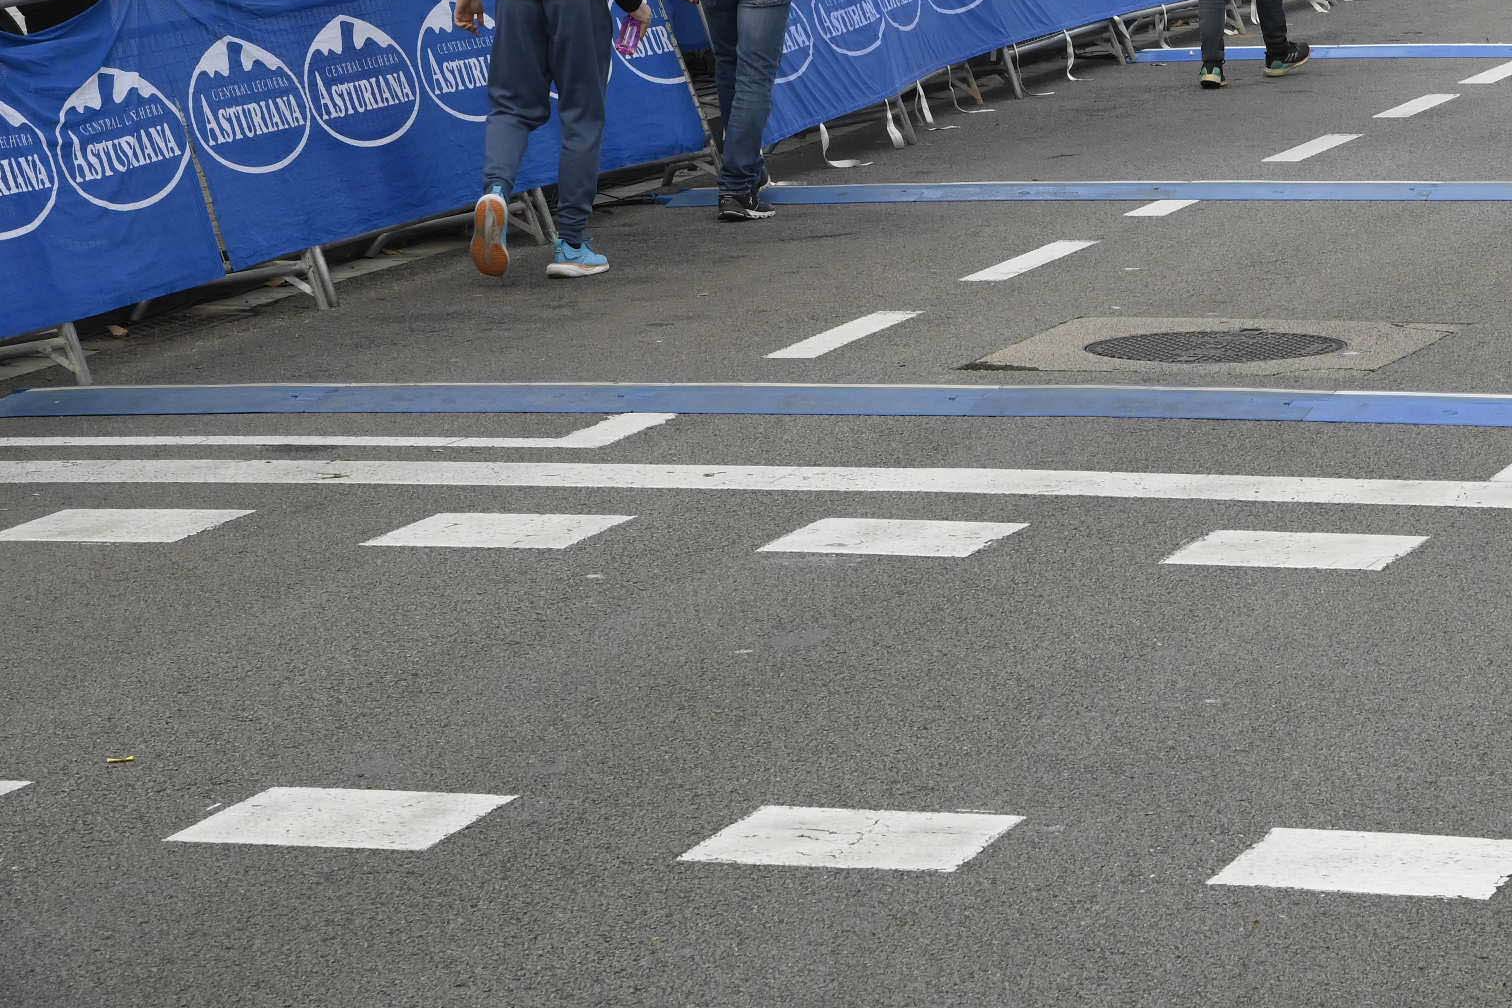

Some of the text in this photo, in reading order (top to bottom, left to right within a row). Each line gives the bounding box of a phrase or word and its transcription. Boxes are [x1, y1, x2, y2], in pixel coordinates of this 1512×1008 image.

[325, 54, 400, 77] CENTRAL LECHERA
[426, 47, 492, 96] ASTURI
[438, 39, 470, 55] CENTRAL
[212, 76, 289, 99] CENTRAL LECHERA
[316, 68, 414, 121] ASTURIANA
[202, 95, 305, 146] ASTURIANA
[73, 124, 181, 182] ASTURIANA
